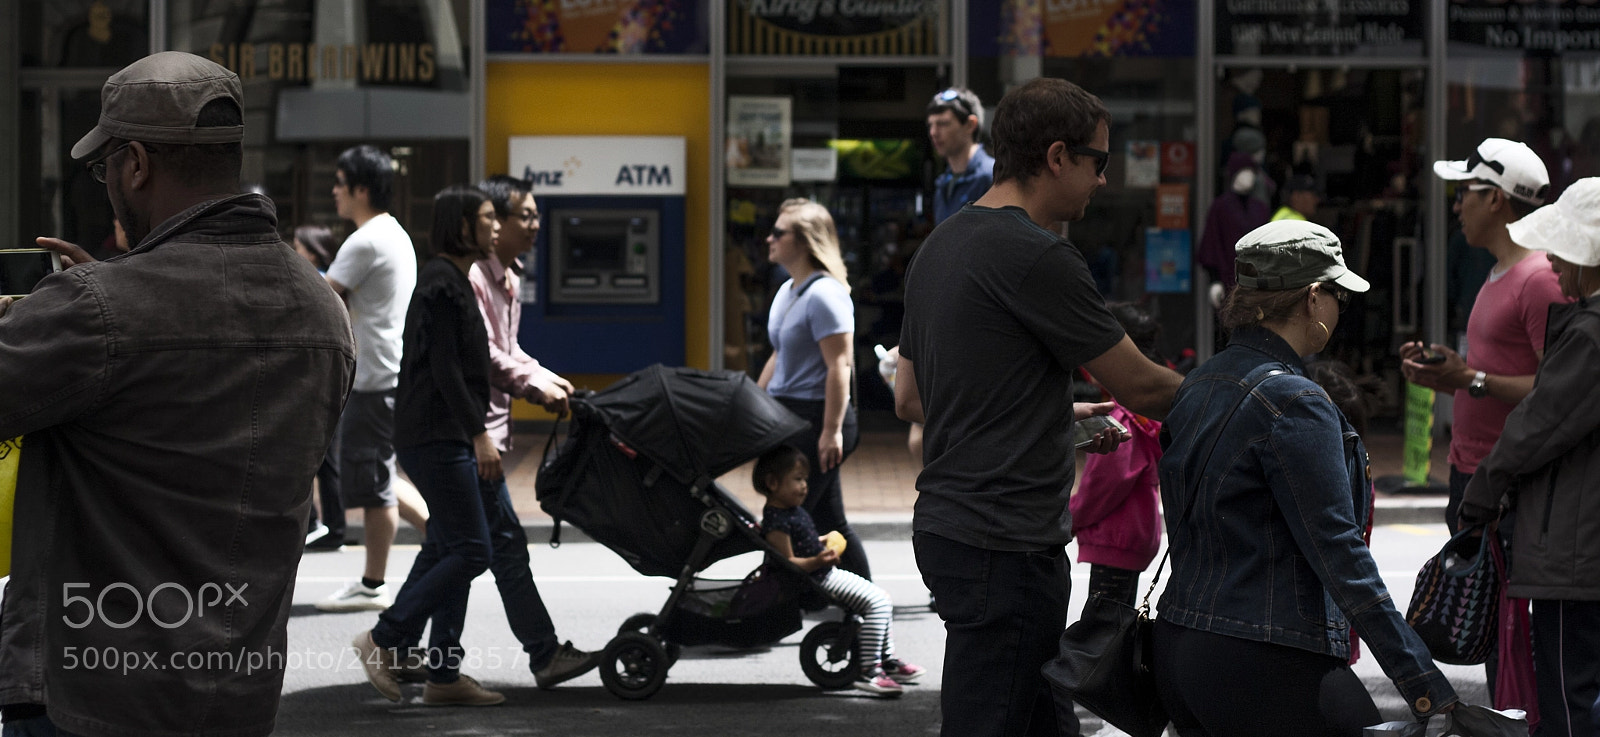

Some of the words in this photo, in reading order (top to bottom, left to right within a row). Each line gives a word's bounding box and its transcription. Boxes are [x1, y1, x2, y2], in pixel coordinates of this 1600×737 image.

[1449, 5, 1505, 22] Possum
[1507, 4, 1521, 22] &
[1522, 6, 1574, 22] Merino
[1267, 21, 1301, 44] New
[1302, 21, 1362, 44] Zealand
[1363, 21, 1405, 42] Made
[1485, 24, 1519, 48] No
[209, 42, 256, 79] SIR
[267, 42, 436, 81] BREADWINS
[523, 165, 563, 186] bnz
[616, 164, 672, 186] ATM
